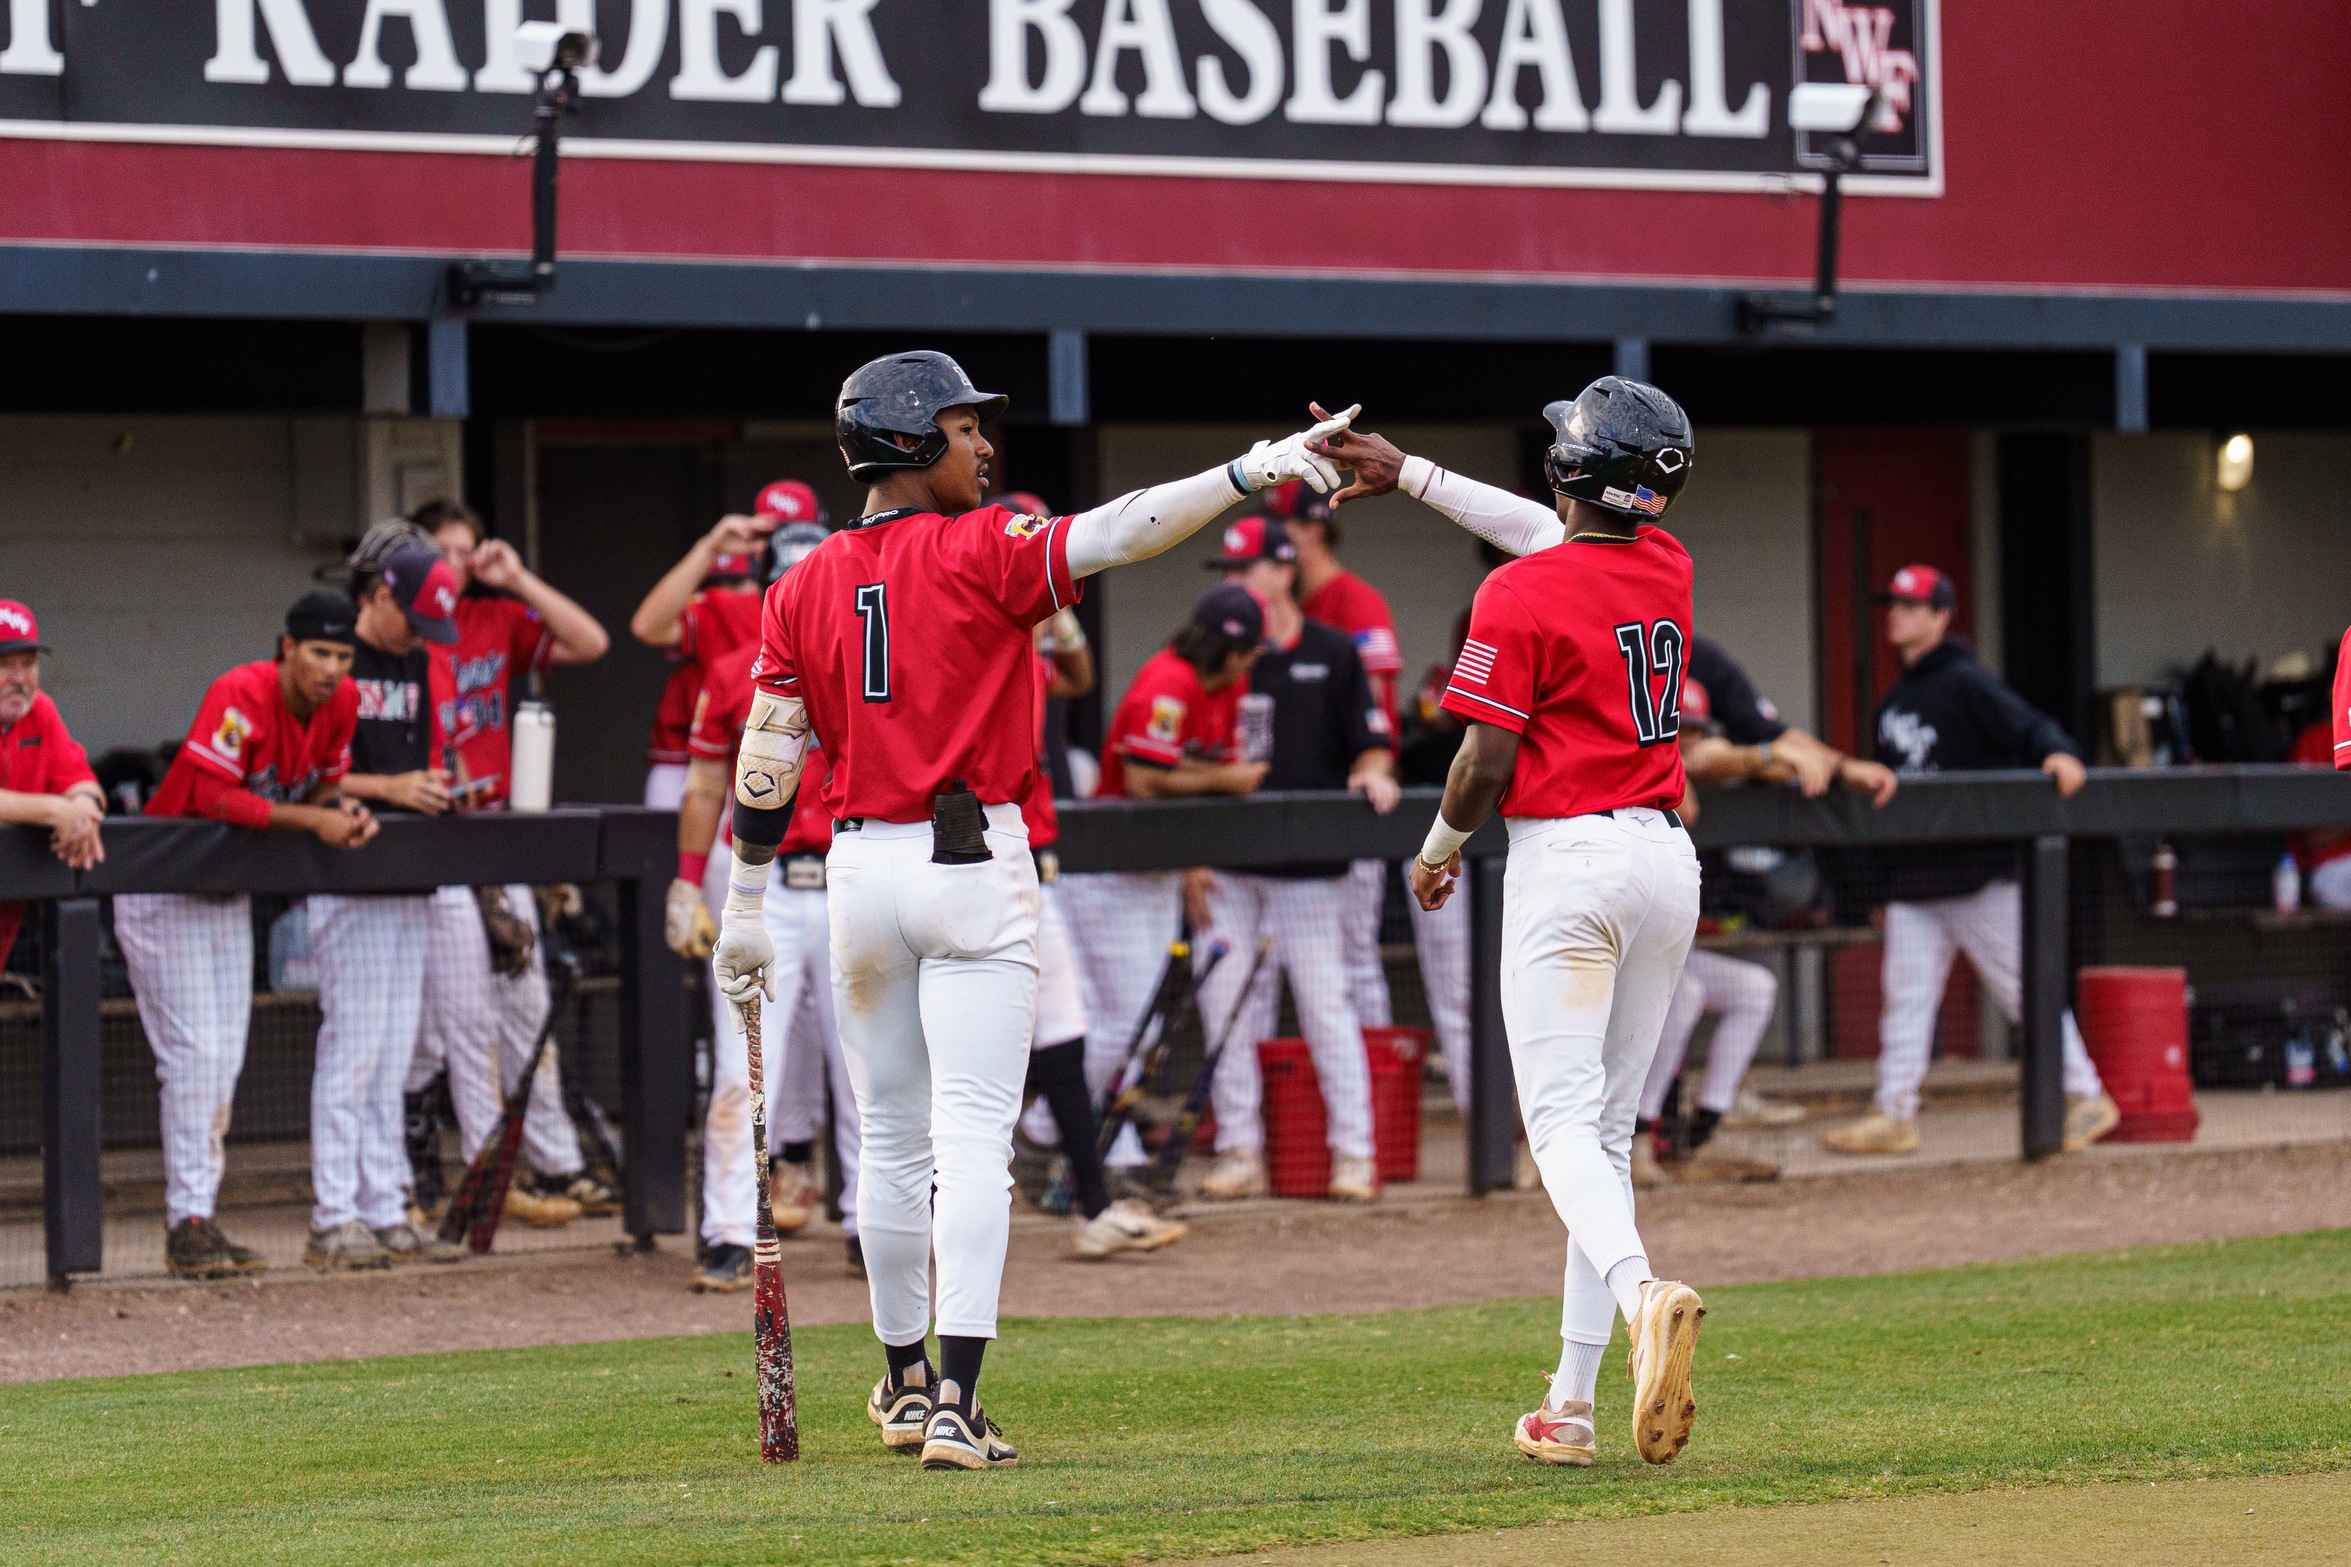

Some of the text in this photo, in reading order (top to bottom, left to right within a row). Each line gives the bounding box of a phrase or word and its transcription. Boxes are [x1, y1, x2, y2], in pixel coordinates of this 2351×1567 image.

[978, 0, 1771, 138] BASEBALL
[854, 580, 892, 704] 1
[1613, 617, 1684, 748] 12
[904, 1410, 926, 1421] NIKE
[933, 1426, 957, 1437] NIKE
